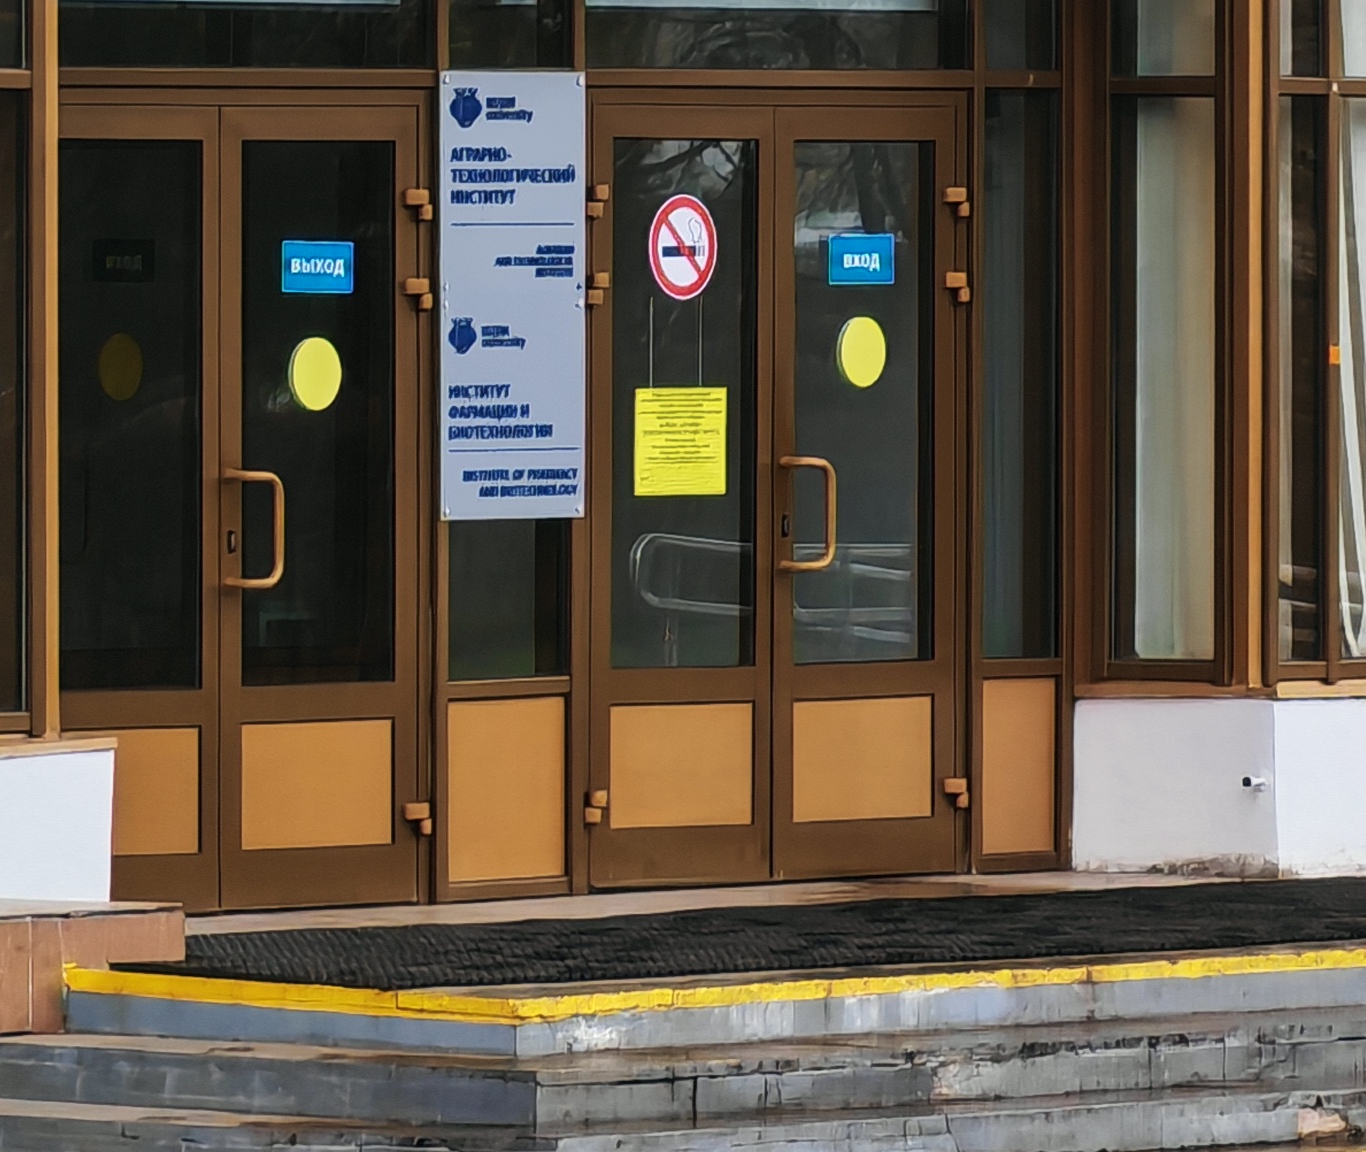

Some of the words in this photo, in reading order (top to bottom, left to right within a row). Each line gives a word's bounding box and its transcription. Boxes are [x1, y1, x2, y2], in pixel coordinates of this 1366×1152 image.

[450, 189, 516, 204] ИНСТИТУТ
[290, 258, 345, 277] ВЫХОД
[843, 253, 880, 272] ВХОД
